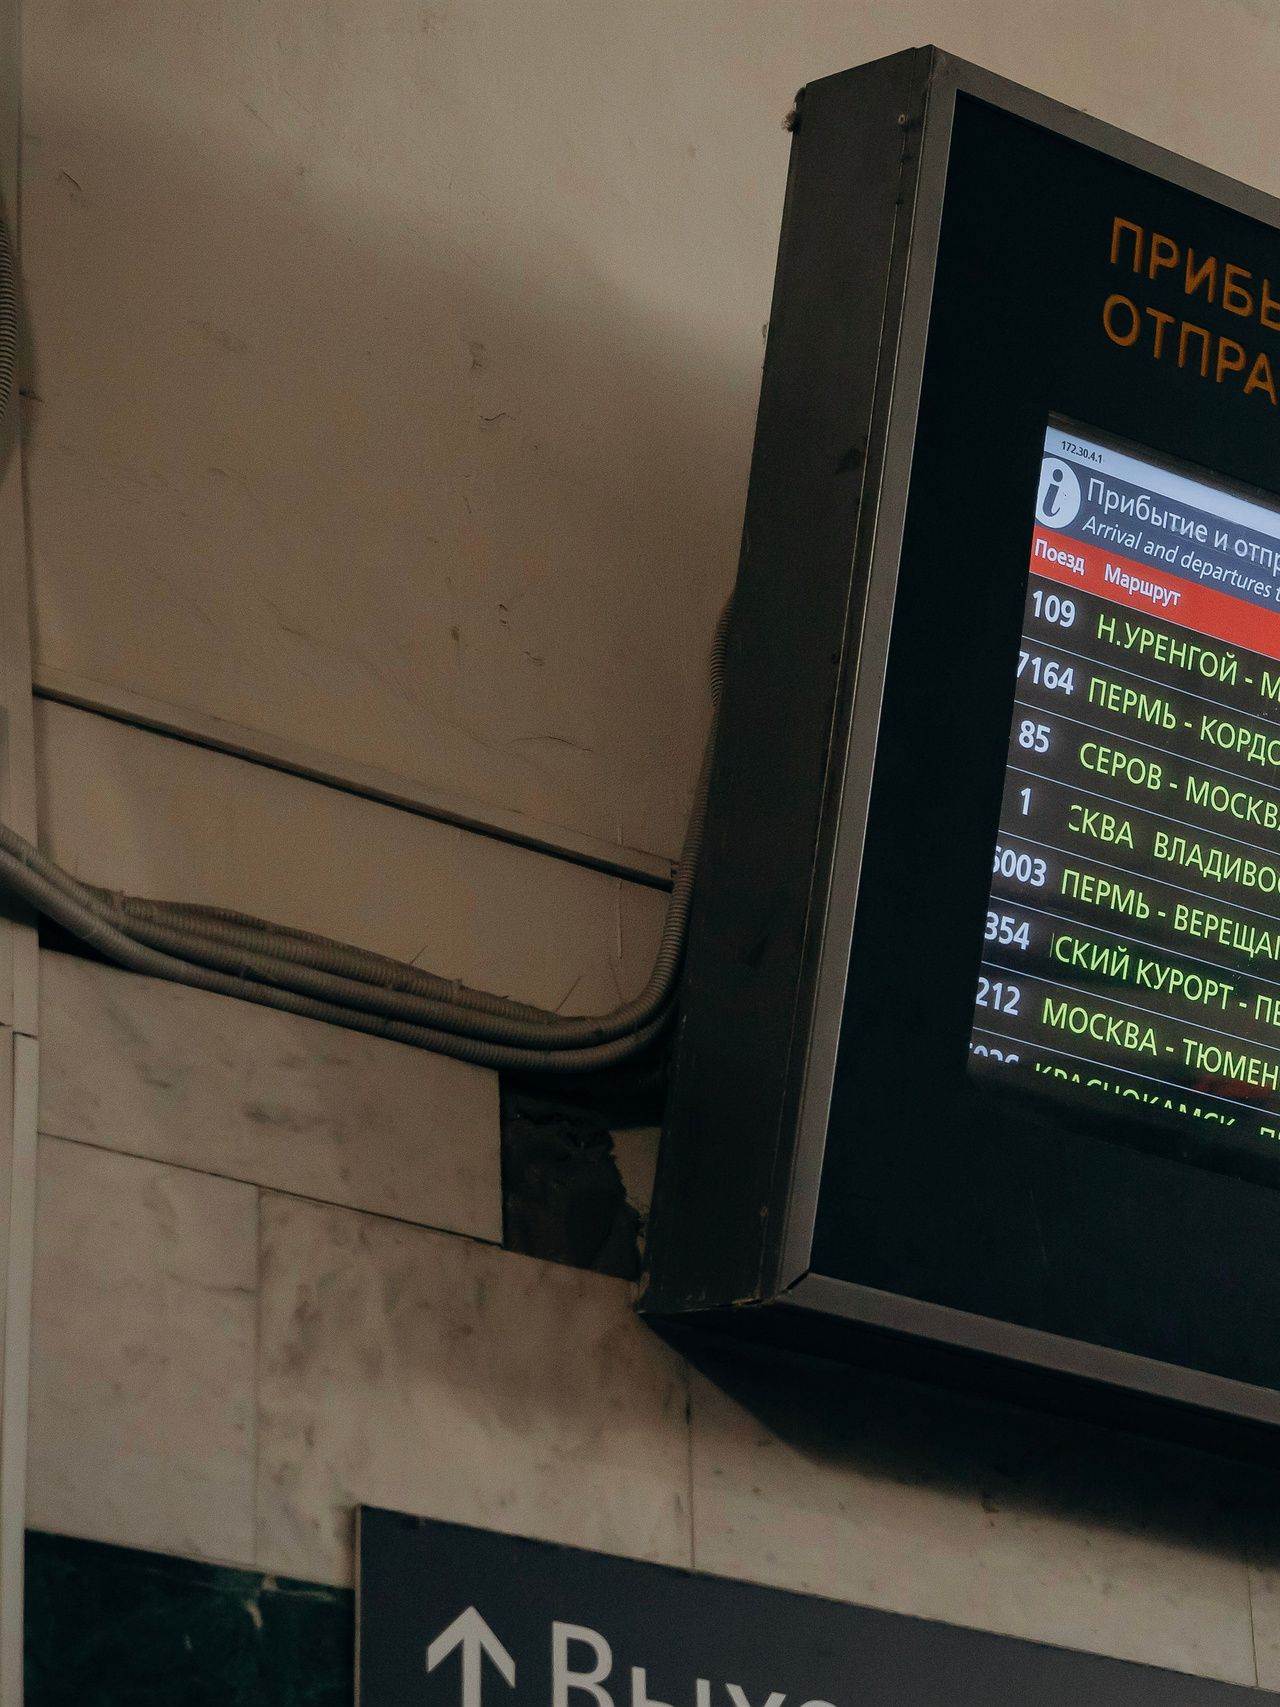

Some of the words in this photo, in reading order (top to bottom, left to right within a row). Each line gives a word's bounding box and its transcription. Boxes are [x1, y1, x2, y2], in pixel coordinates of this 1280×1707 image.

[1062, 441, 1103, 464] 172.30.4.1
[1088, 478, 1208, 543] Прибытие
[1215, 533, 1229, 552] и
[1034, 539, 1085, 576] Поезд
[1104, 564, 1181, 606] Маршрут
[1082, 515, 1141, 550] Arrival
[1144, 537, 1177, 563] and
[1180, 548, 1272, 599] departures
[1032, 590, 1076, 628] 109
[1097, 614, 1238, 686] Н.УРЕНГОЙ
[1017, 651, 1074, 695] 7164
[1088, 677, 1176, 731] ПЕРМЬ
[1018, 720, 1051, 753] 85
[1079, 742, 1162, 791] СЕРОВ
[1020, 787, 1032, 816] 1
[1061, 869, 1150, 920] ПЕРМЬ
[984, 911, 1030, 950] 354
[1049, 933, 1129, 980] СКИЙ
[1135, 958, 1234, 1010] КУРОРТ
[975, 977, 1021, 1015] 212
[1042, 998, 1157, 1056] МОСКВА
